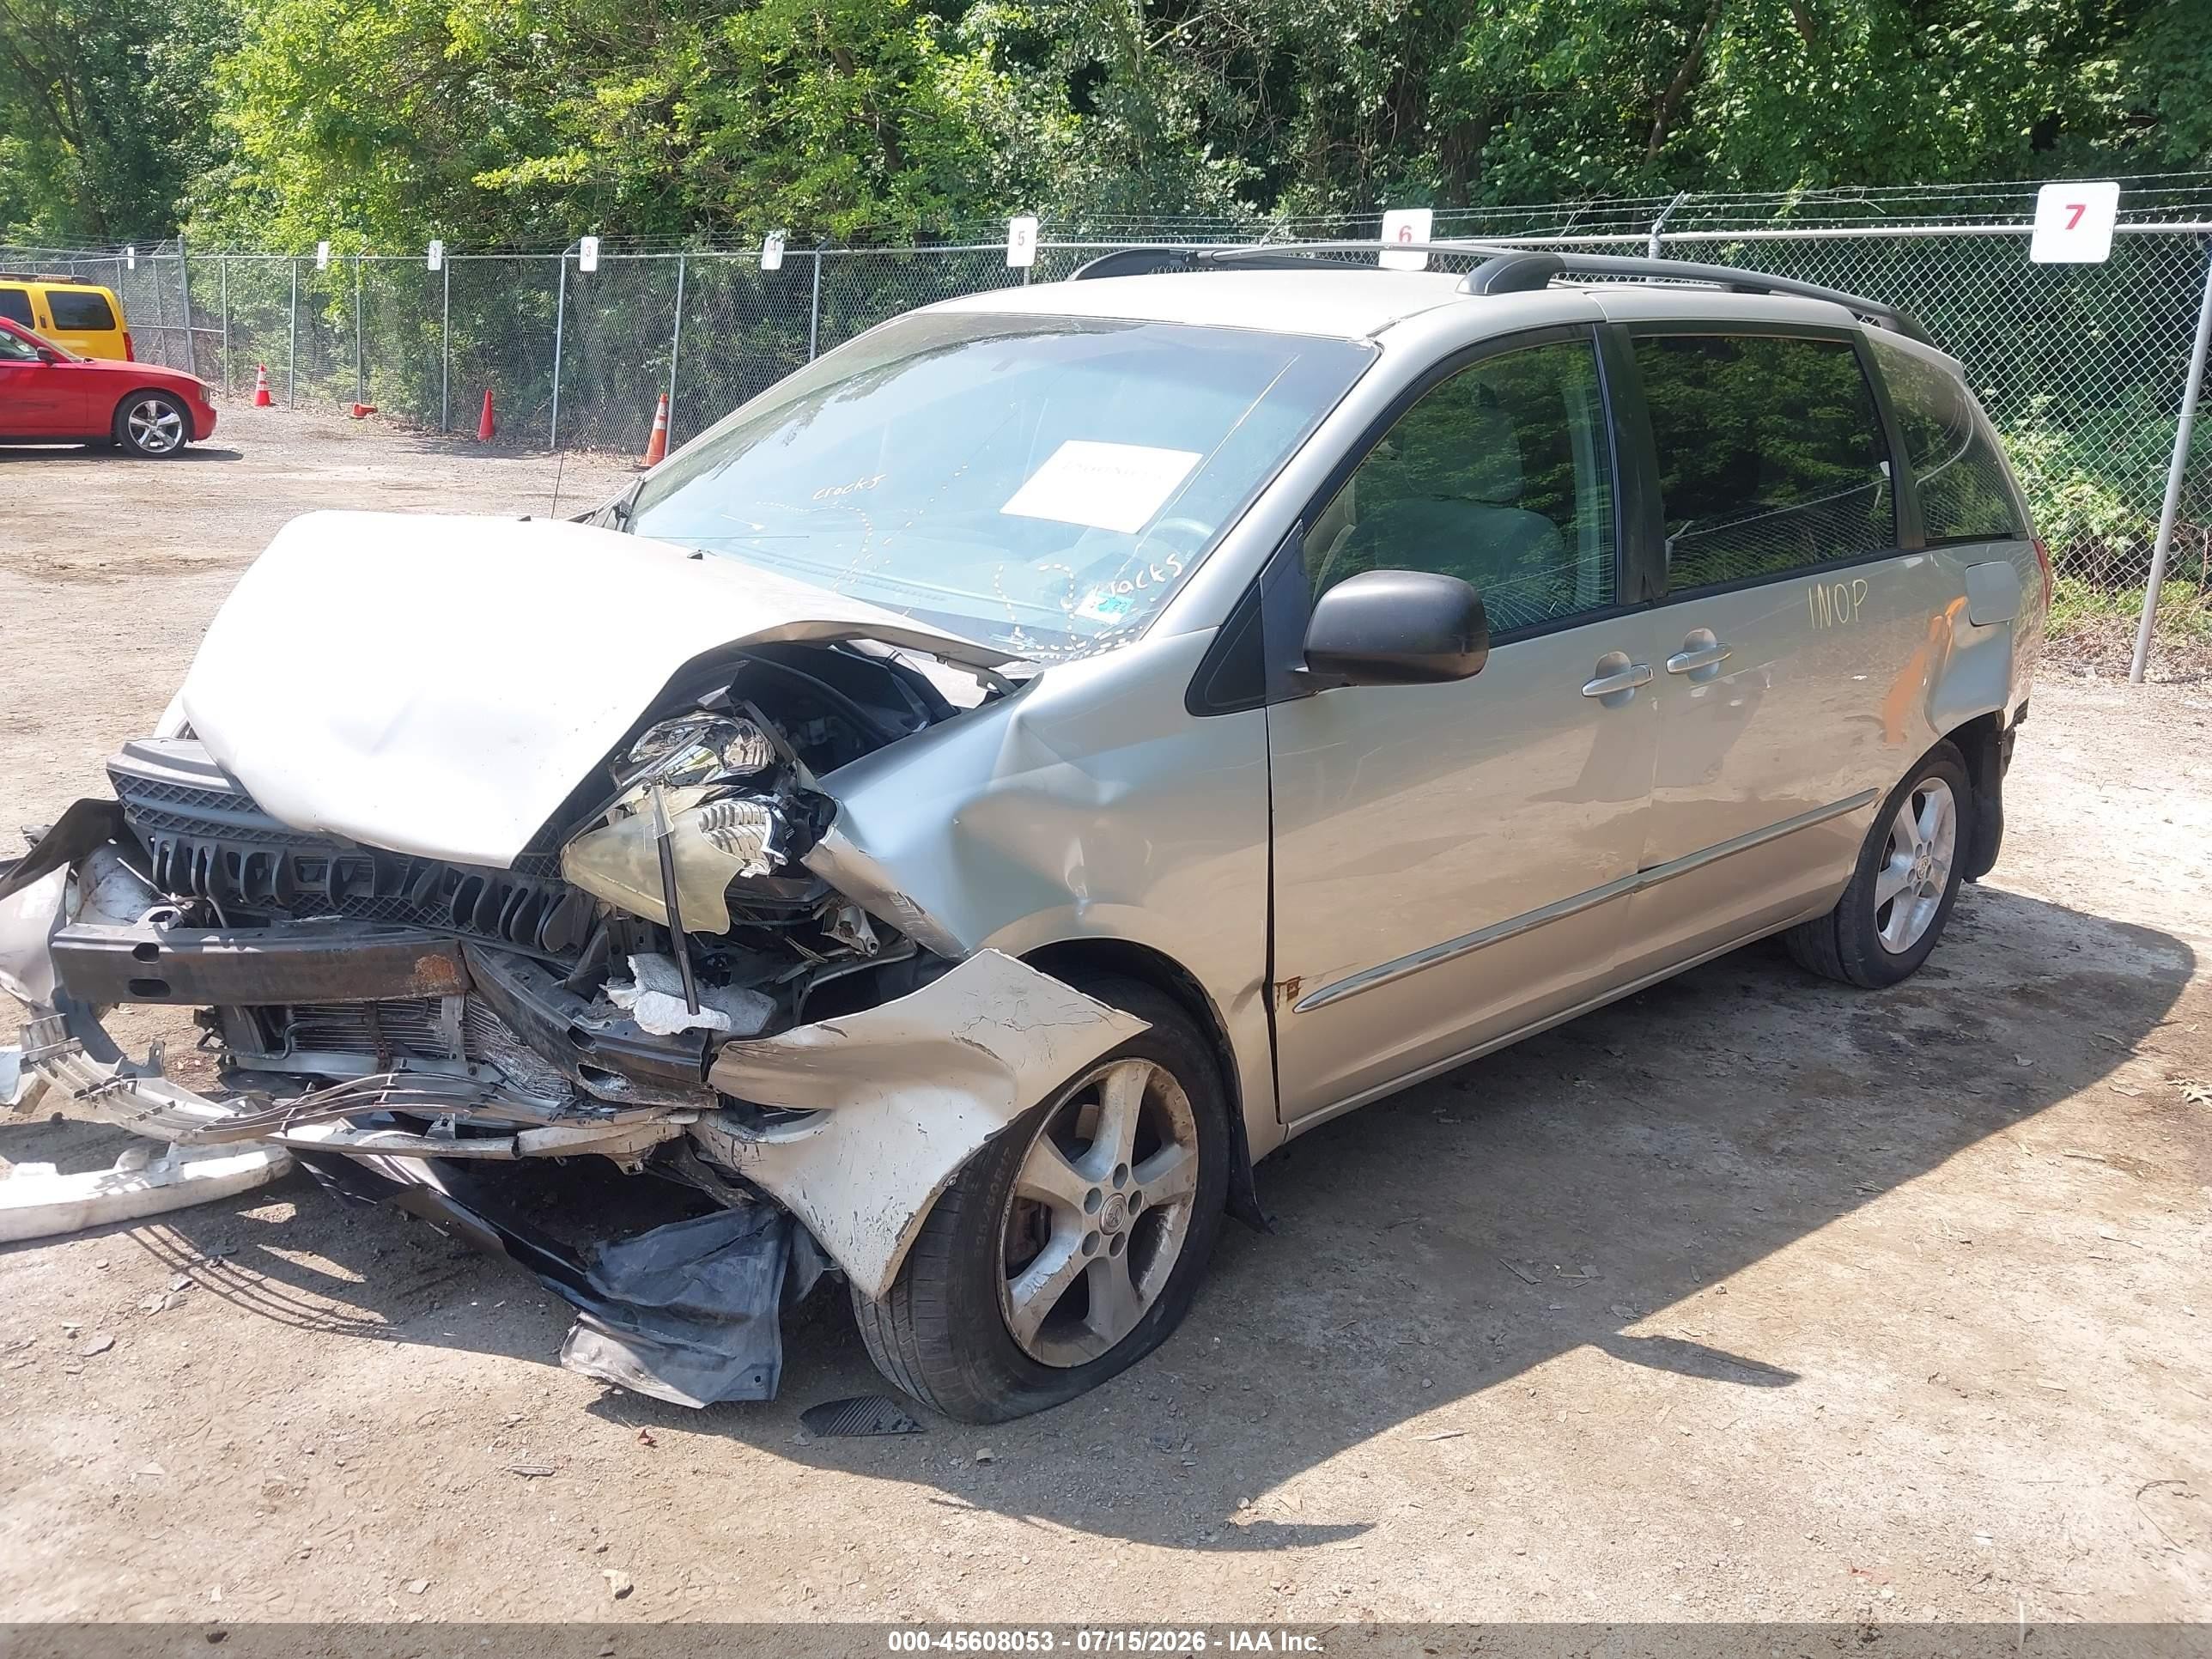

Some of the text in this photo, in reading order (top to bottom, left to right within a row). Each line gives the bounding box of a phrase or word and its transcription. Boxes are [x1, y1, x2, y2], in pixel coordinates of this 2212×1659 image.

[2064, 204, 2087, 230] 7
[1018, 230, 1025, 246] 5
[1399, 225, 1413, 243] 6
[586, 246, 592, 258] 3
[1808, 578, 1869, 630] INOP
